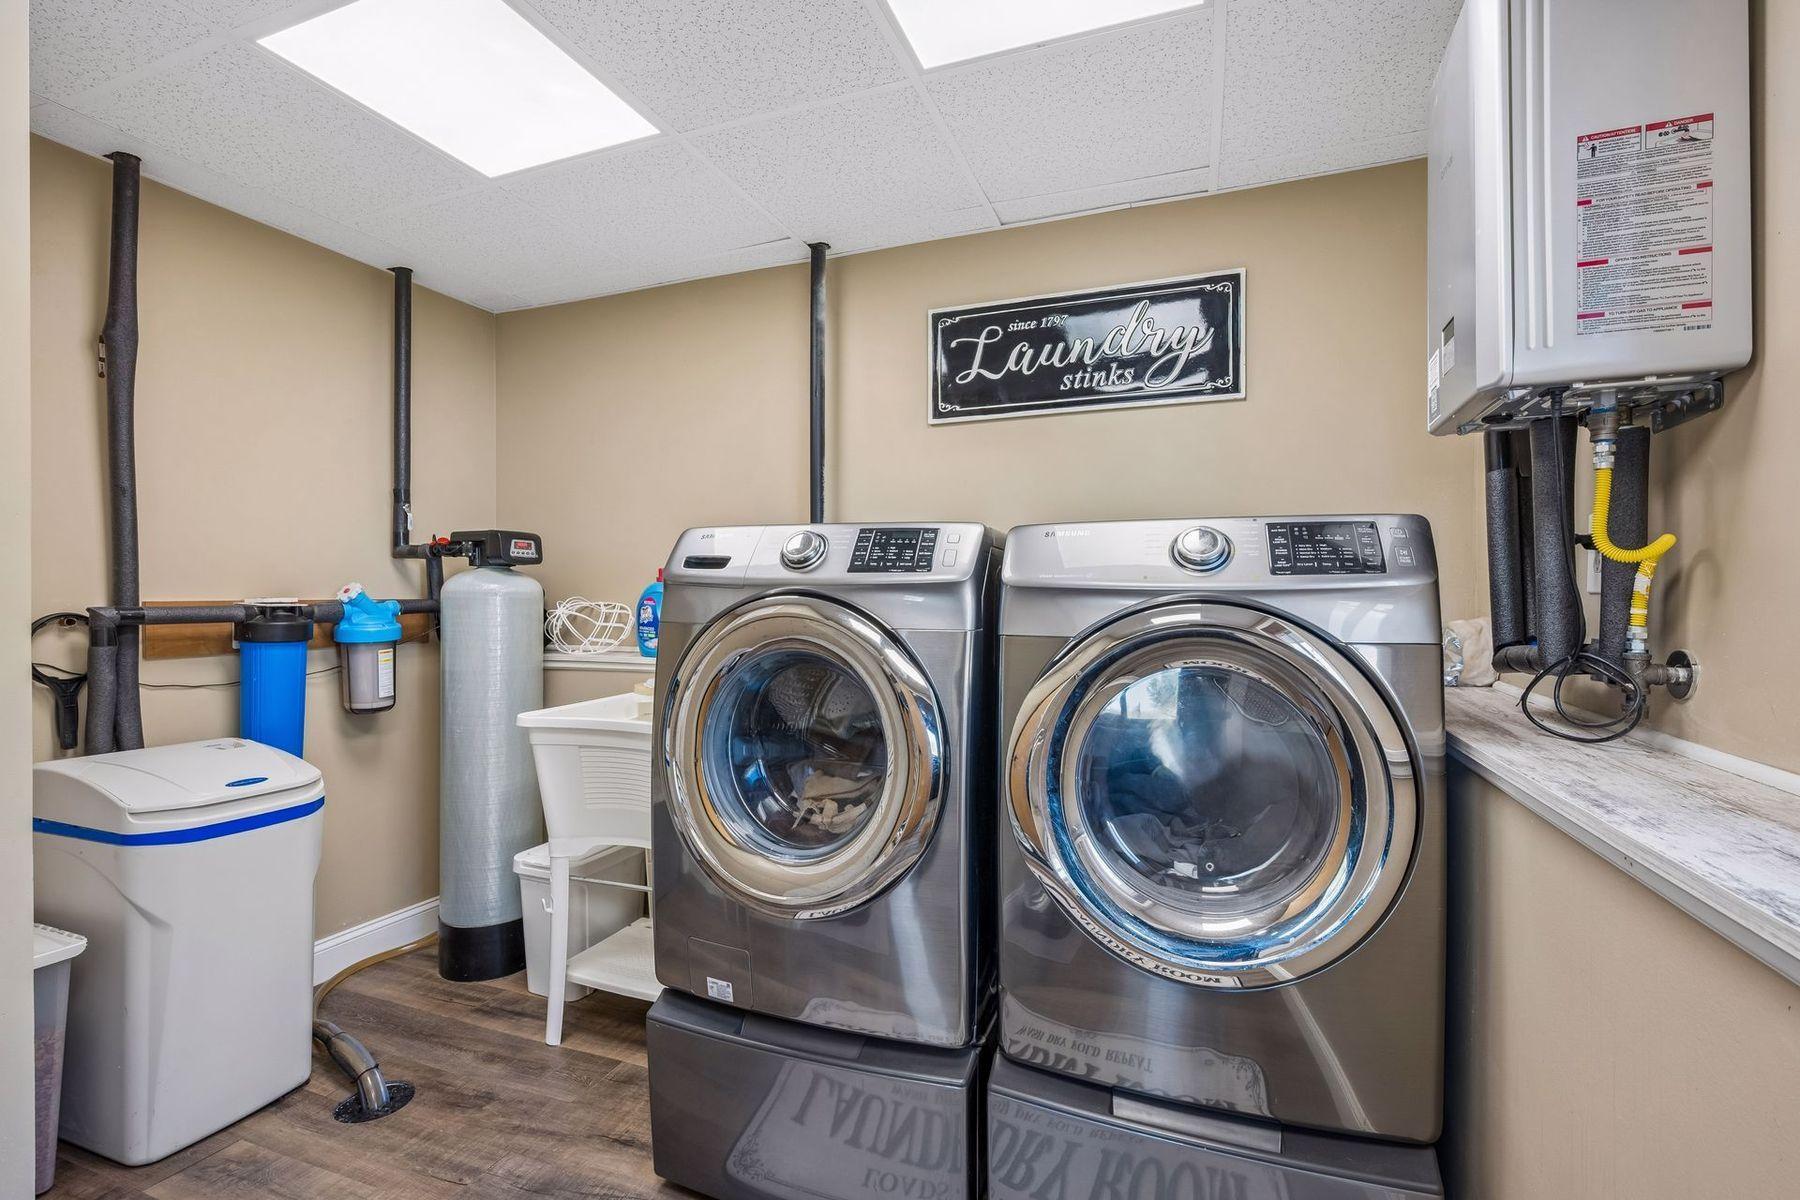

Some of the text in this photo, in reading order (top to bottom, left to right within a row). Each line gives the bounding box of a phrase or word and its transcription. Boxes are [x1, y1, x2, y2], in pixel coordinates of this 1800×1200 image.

[1007, 314, 1068, 332] since 1797
[950, 299, 1214, 388] Laundry
[1060, 363, 1135, 390] stinks
